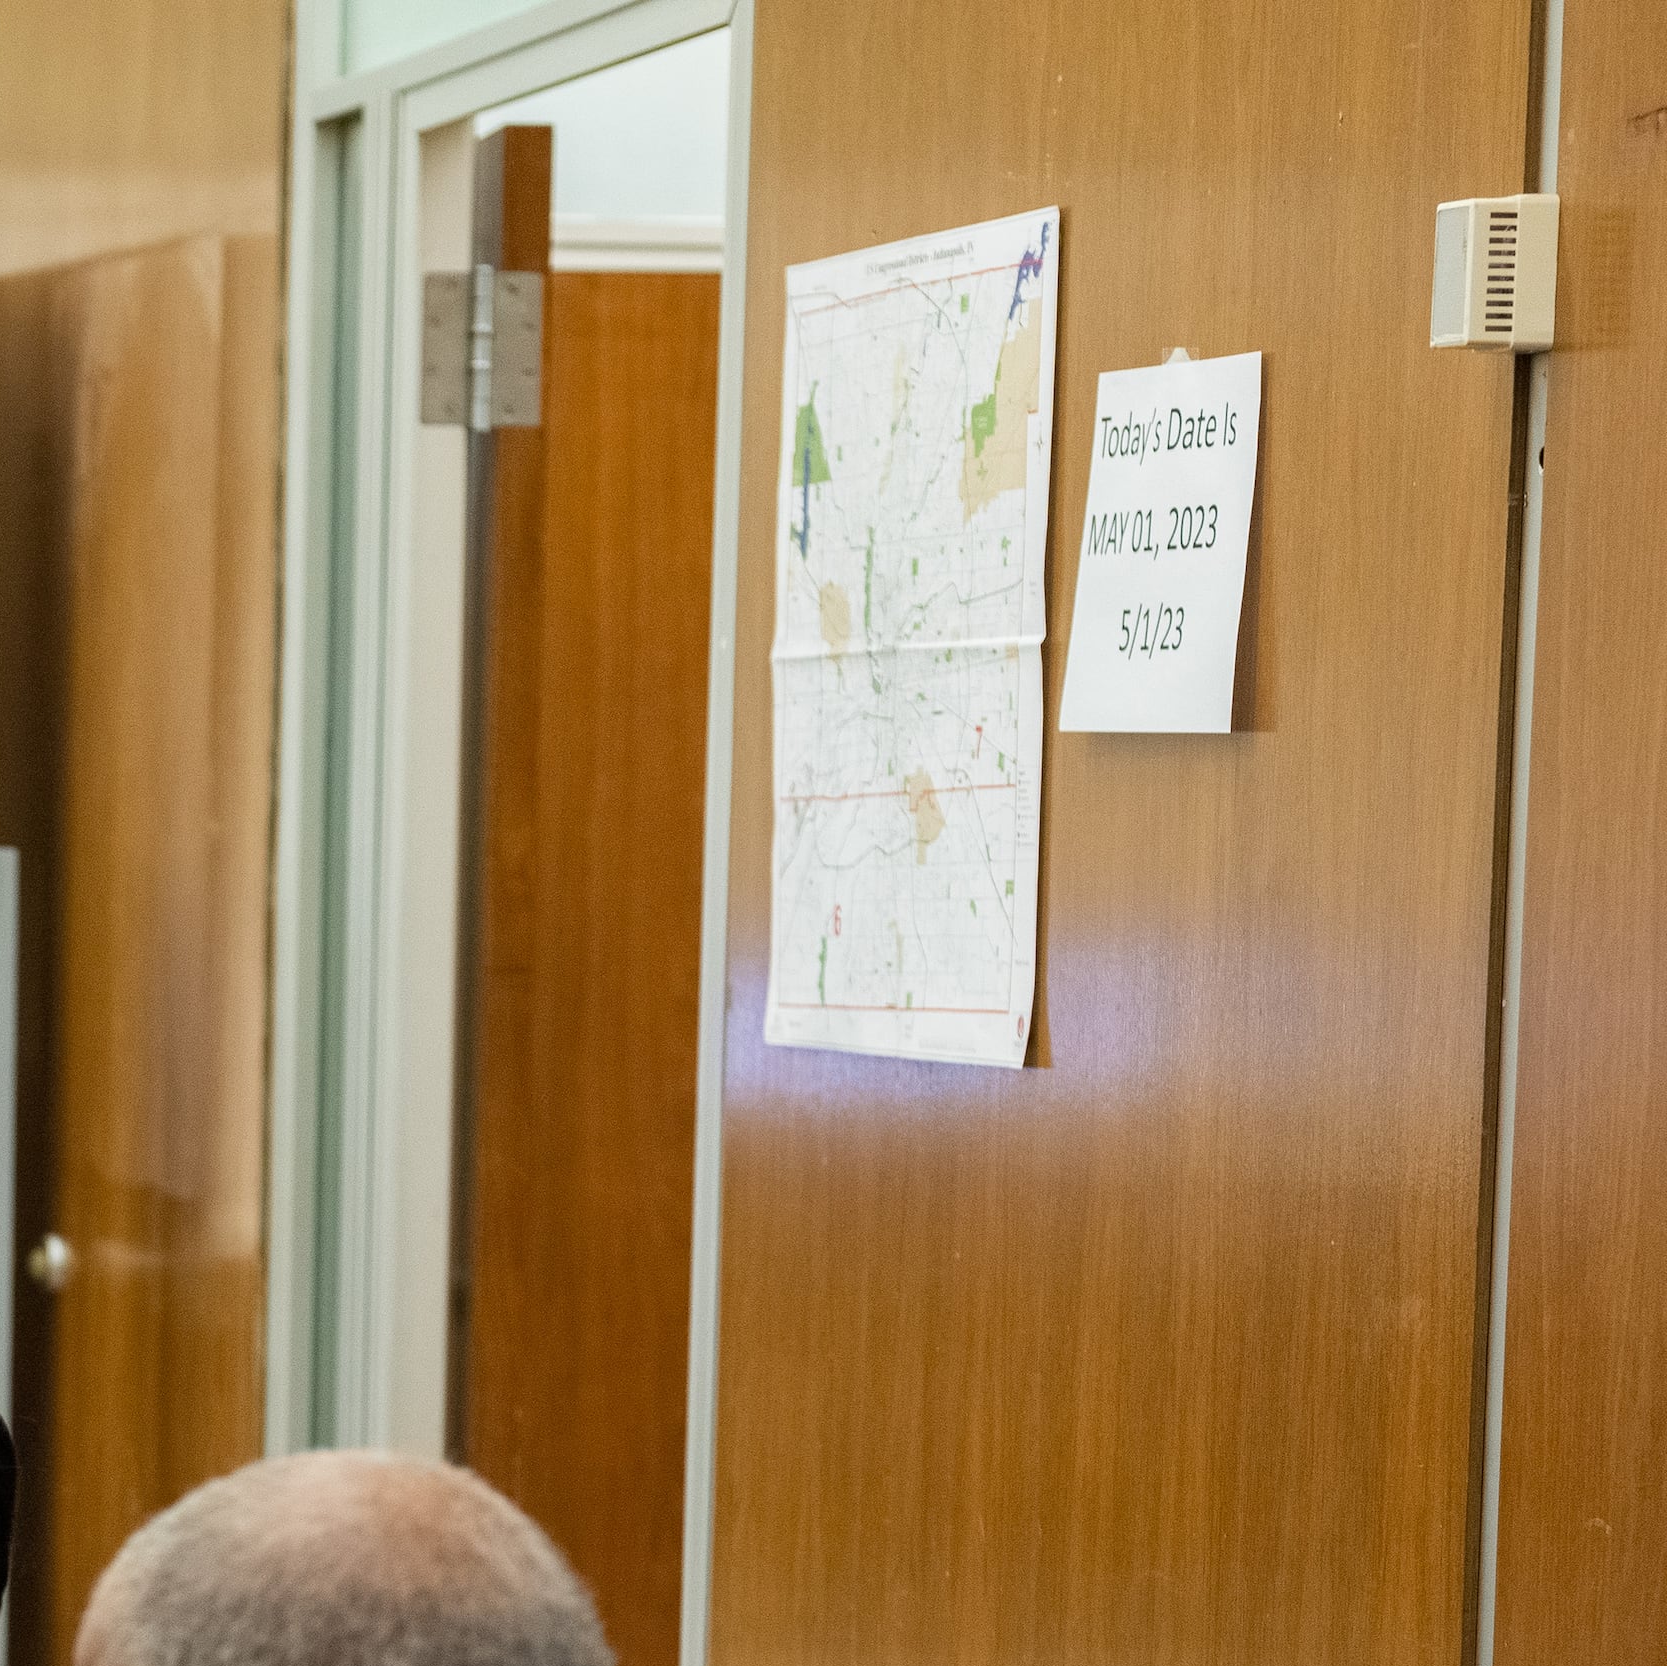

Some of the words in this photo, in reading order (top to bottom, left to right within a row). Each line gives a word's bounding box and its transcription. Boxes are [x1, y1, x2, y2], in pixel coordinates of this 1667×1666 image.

[1101, 407, 1162, 466] Today's
[1166, 407, 1218, 451] Date
[1223, 402, 1237, 447] Is
[1088, 510, 1130, 556] MAY
[1131, 508, 1159, 561] 01,
[1167, 504, 1218, 551] 2023
[1119, 602, 1185, 660] 5/1/23
